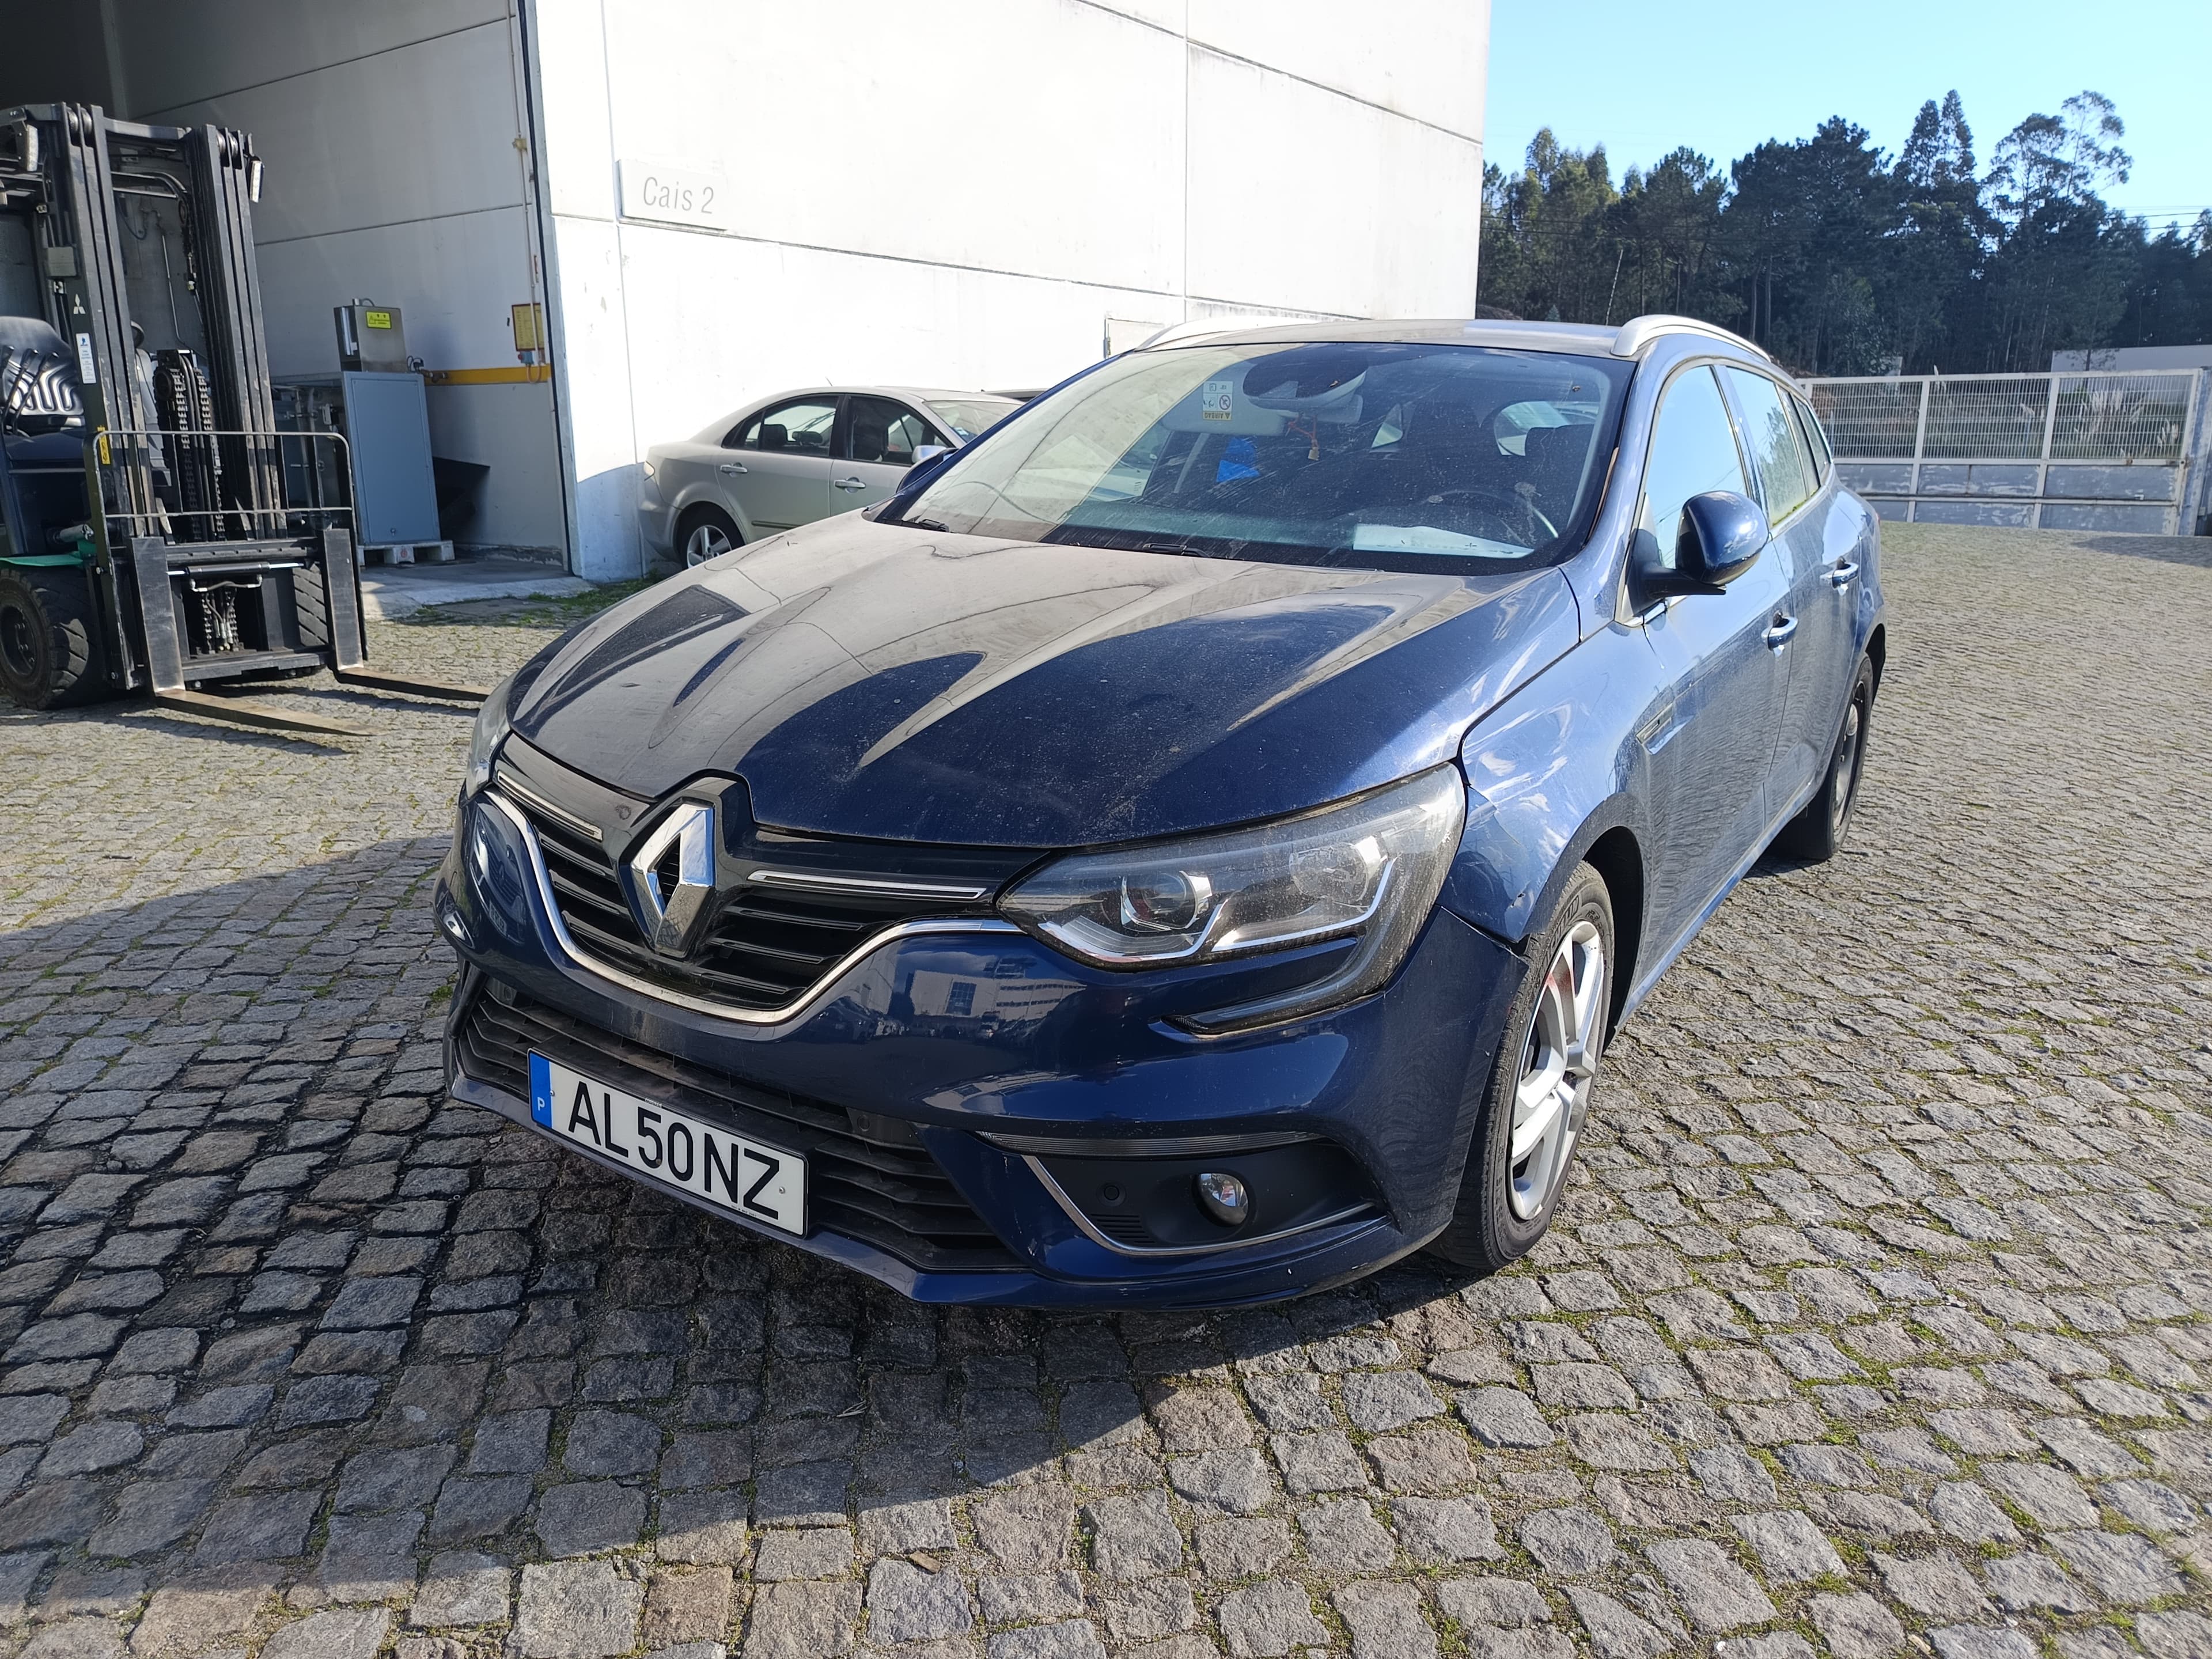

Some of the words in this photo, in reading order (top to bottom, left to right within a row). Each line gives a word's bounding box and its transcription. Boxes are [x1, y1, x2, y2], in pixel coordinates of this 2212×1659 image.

[643, 176, 693, 211] Cais
[700, 186, 714, 214] 2
[537, 1096, 546, 1111] P
